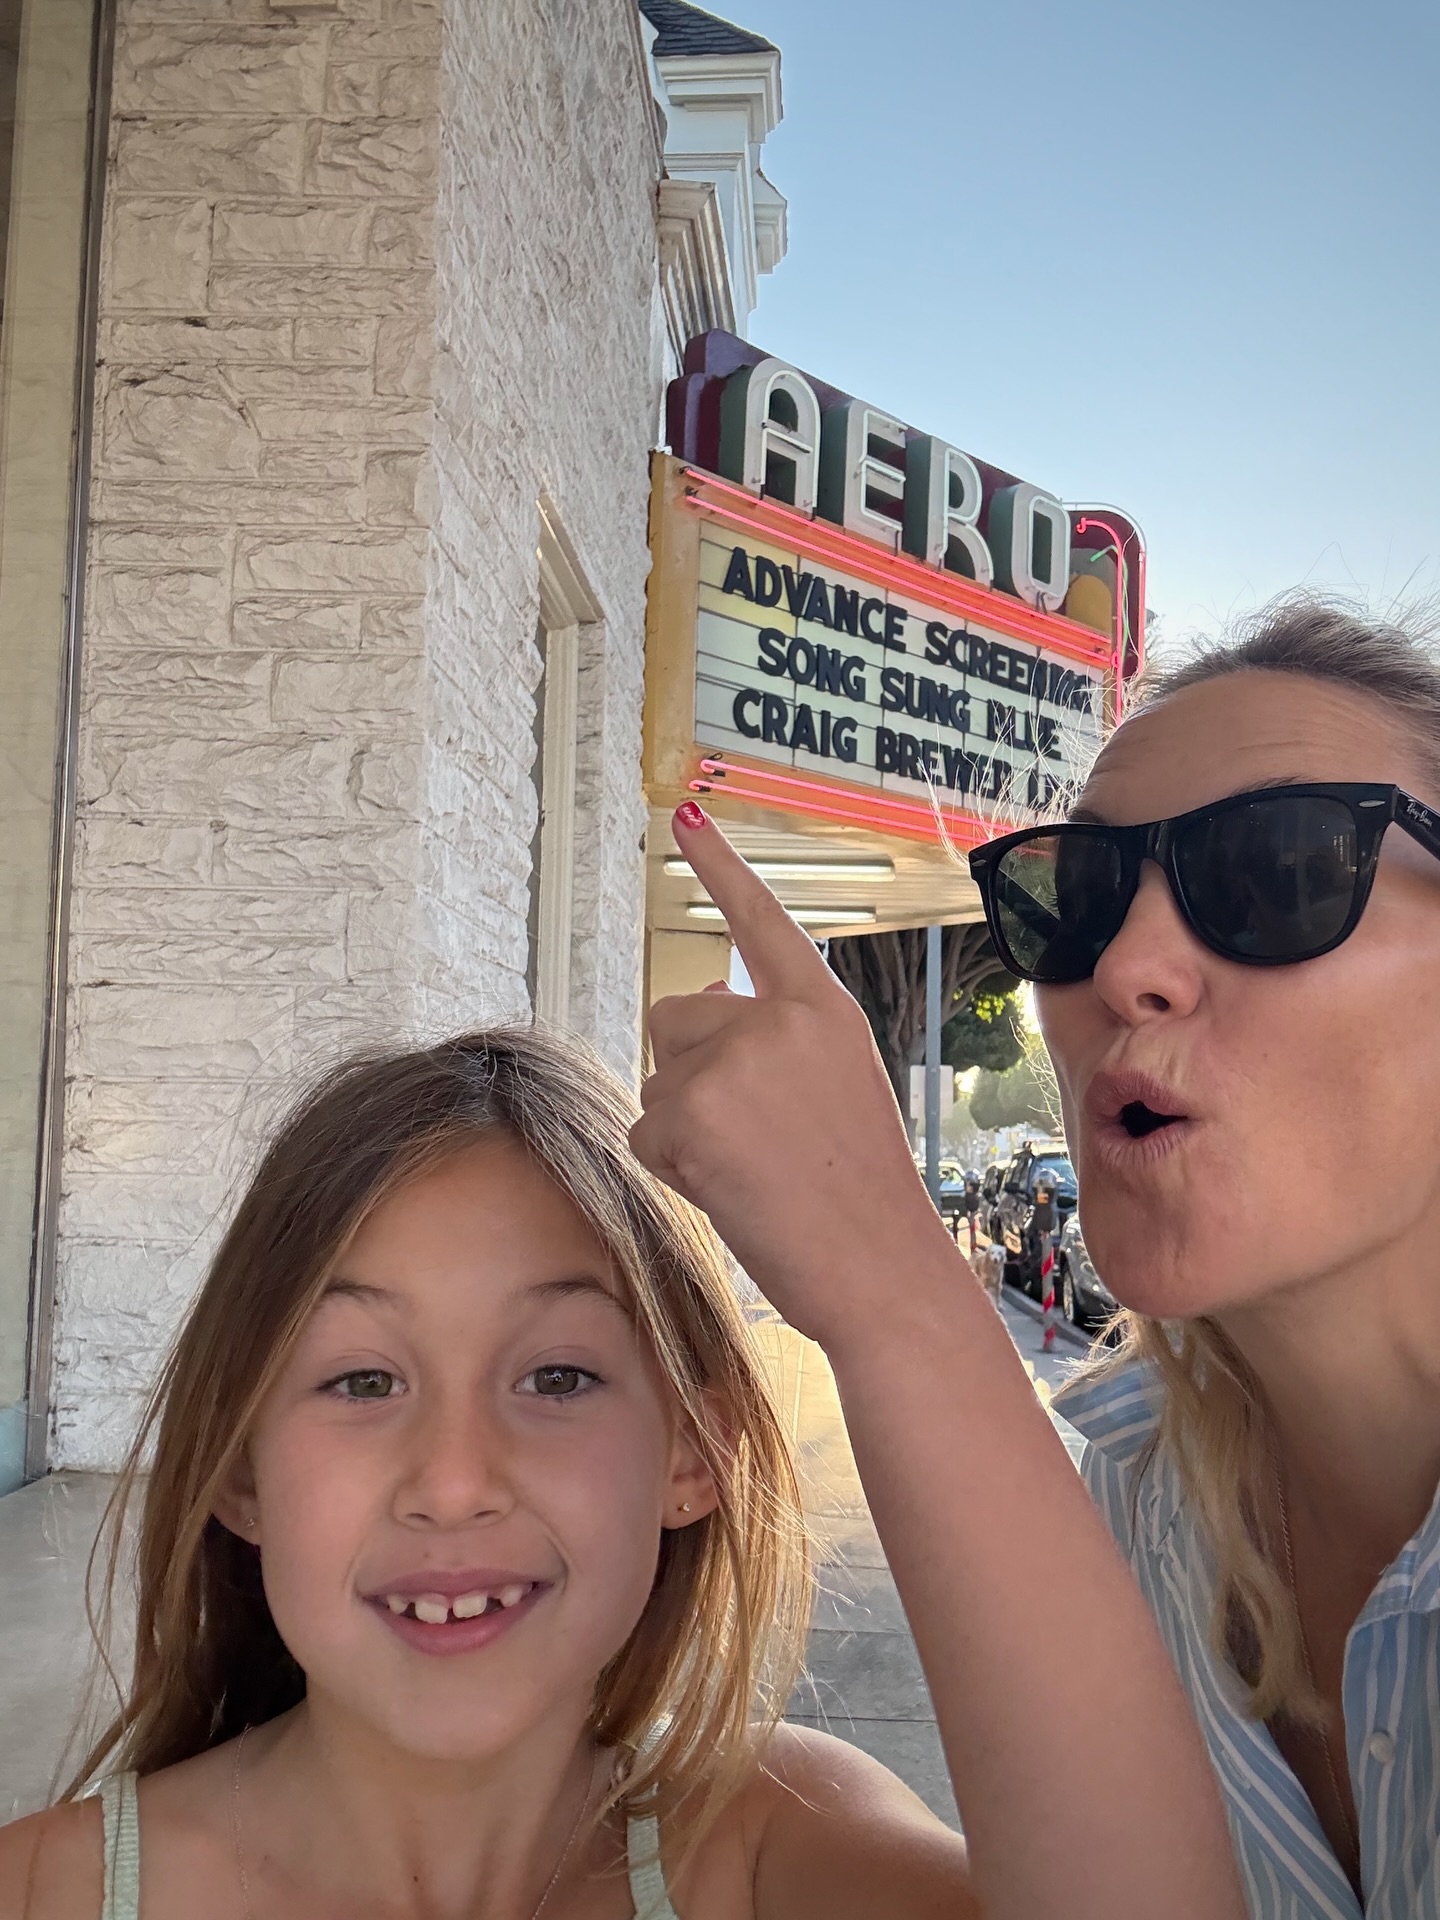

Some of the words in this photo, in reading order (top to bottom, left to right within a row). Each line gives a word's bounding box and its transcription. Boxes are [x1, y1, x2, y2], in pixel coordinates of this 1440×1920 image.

[742, 357, 1071, 612] AERO
[722, 546, 907, 653] ADVANCE
[925, 621, 1092, 715] SCREENING
[758, 627, 866, 703] SONG
[880, 667, 971, 734] SUNG
[987, 698, 1062, 761] BLUE
[732, 688, 858, 763] CRAIG
[875, 726, 1014, 803] BREWER
